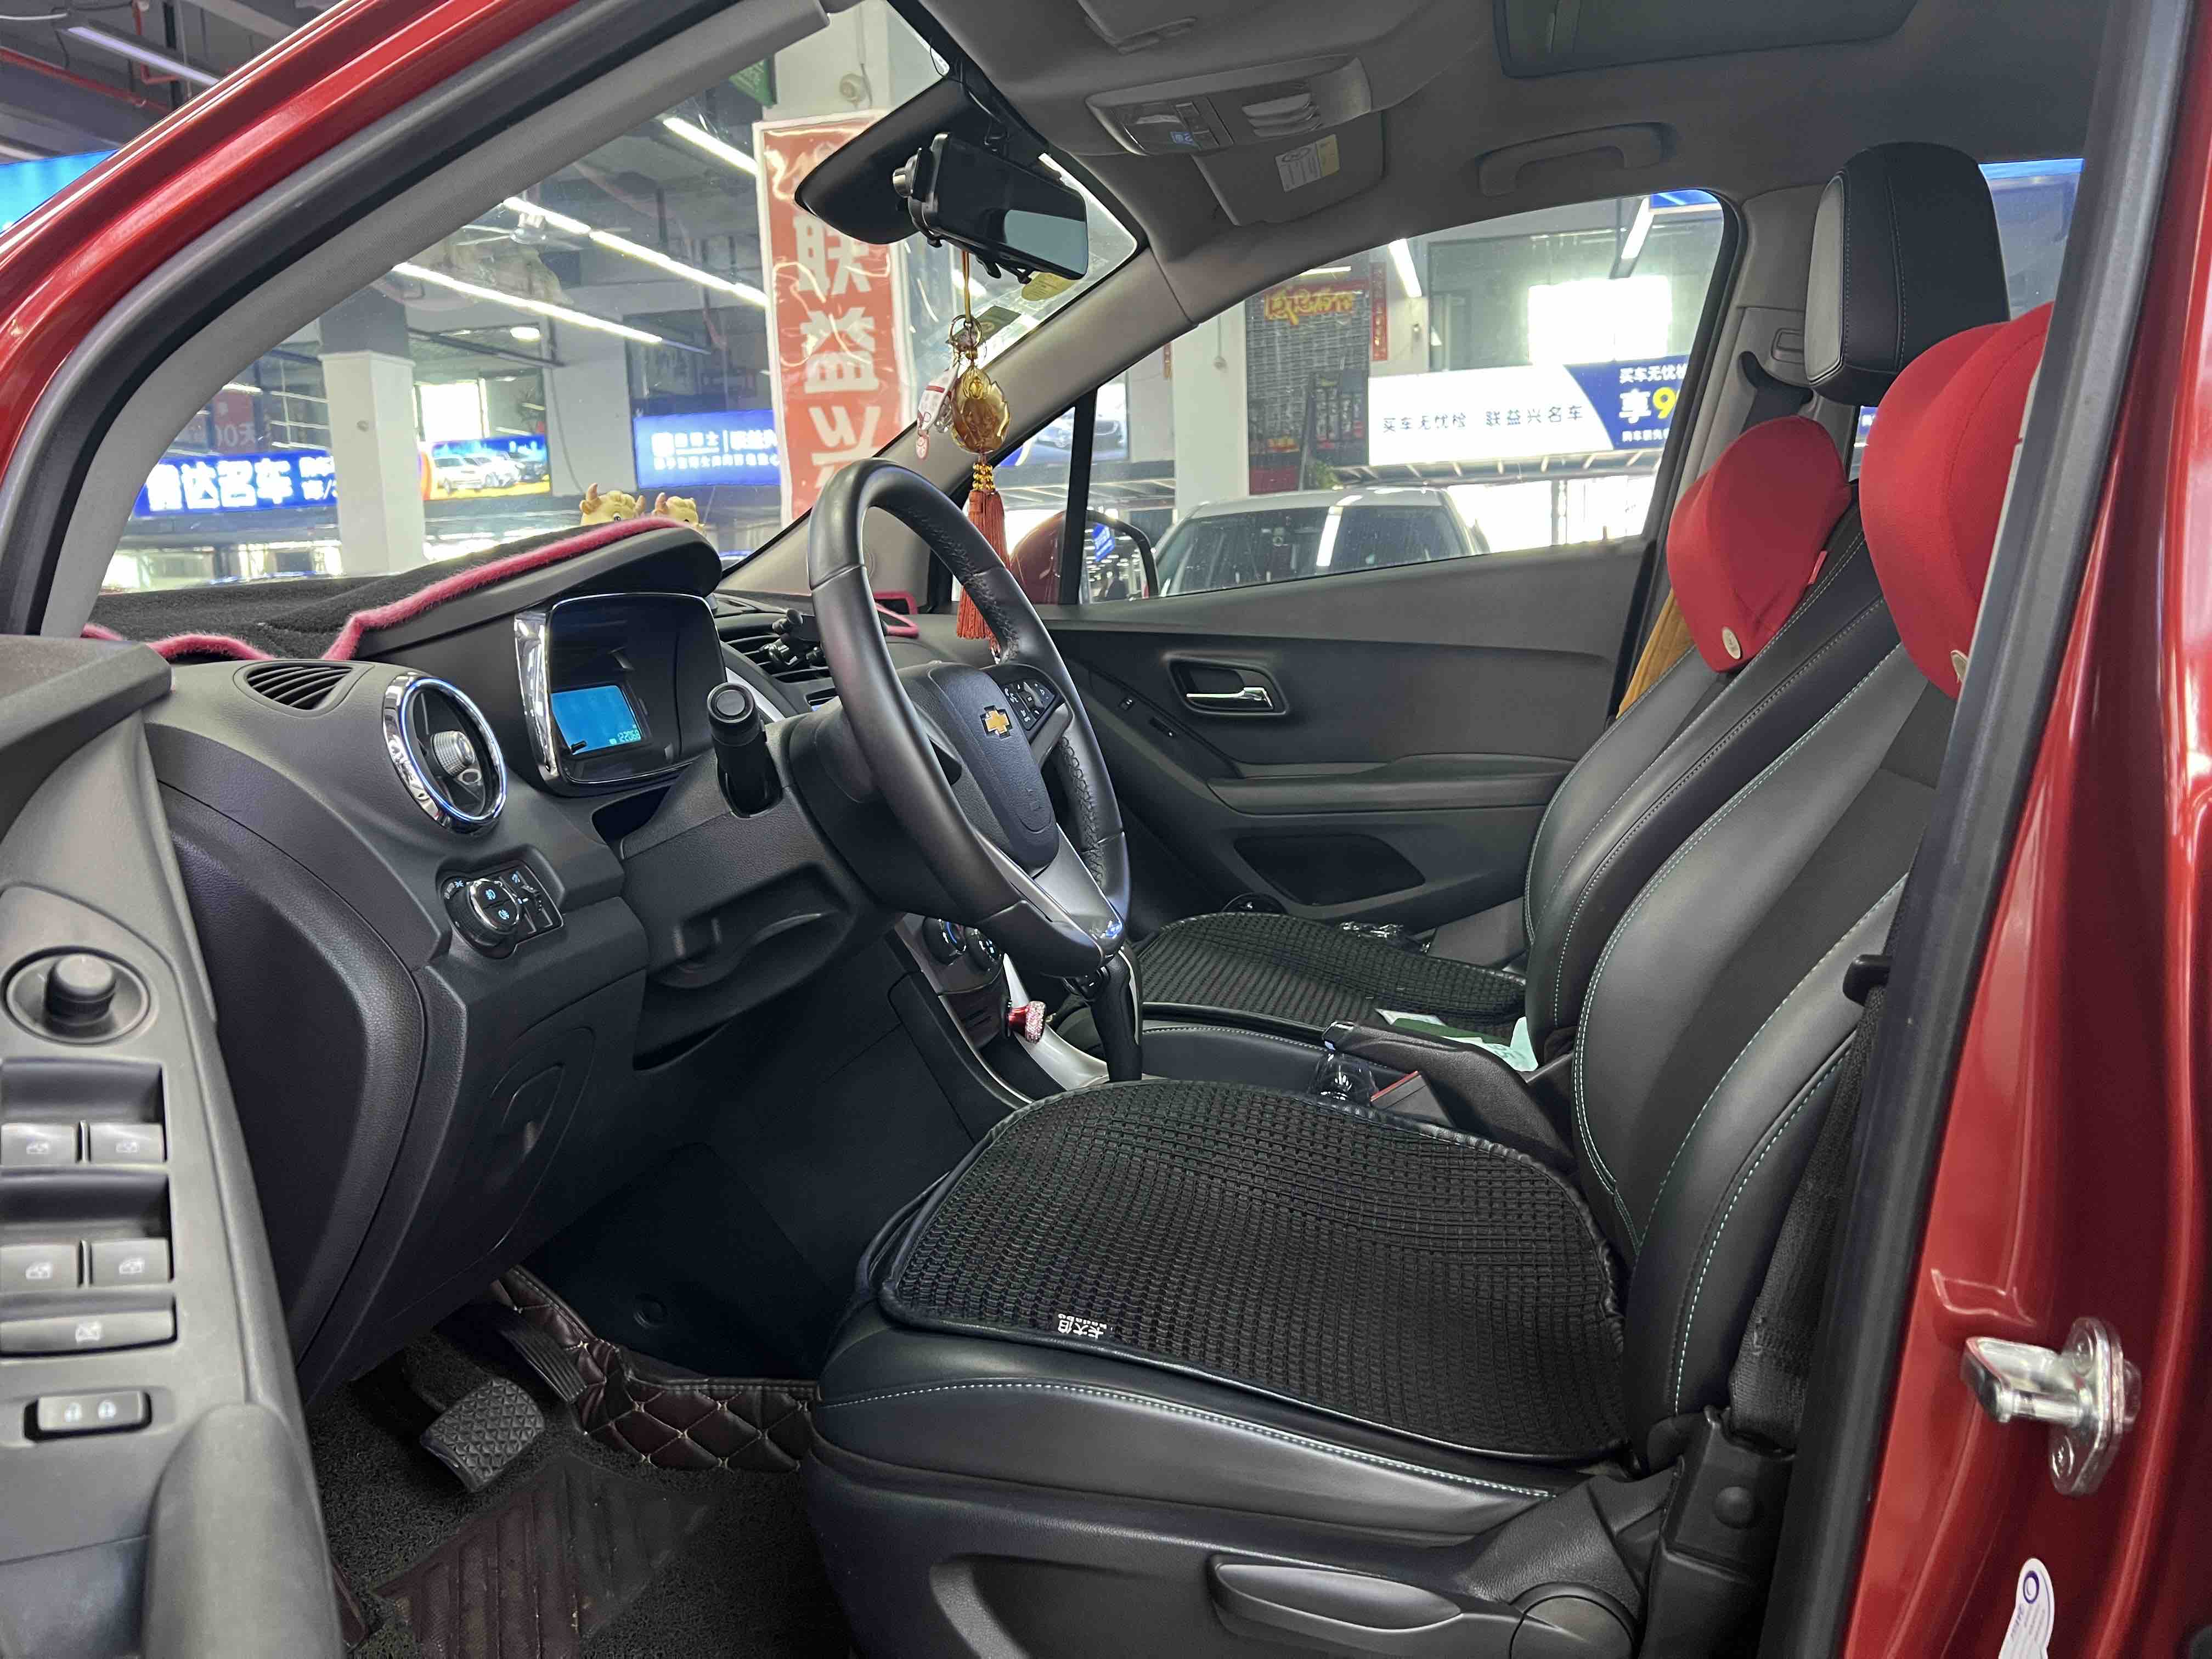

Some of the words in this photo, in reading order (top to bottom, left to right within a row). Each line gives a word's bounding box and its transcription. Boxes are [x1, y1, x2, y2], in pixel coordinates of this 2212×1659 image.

[1485, 405, 1583, 427] 联益兴名车
[1619, 387, 1680, 424] 享9
[1058, 1319, 1104, 1339] 卡大伯
